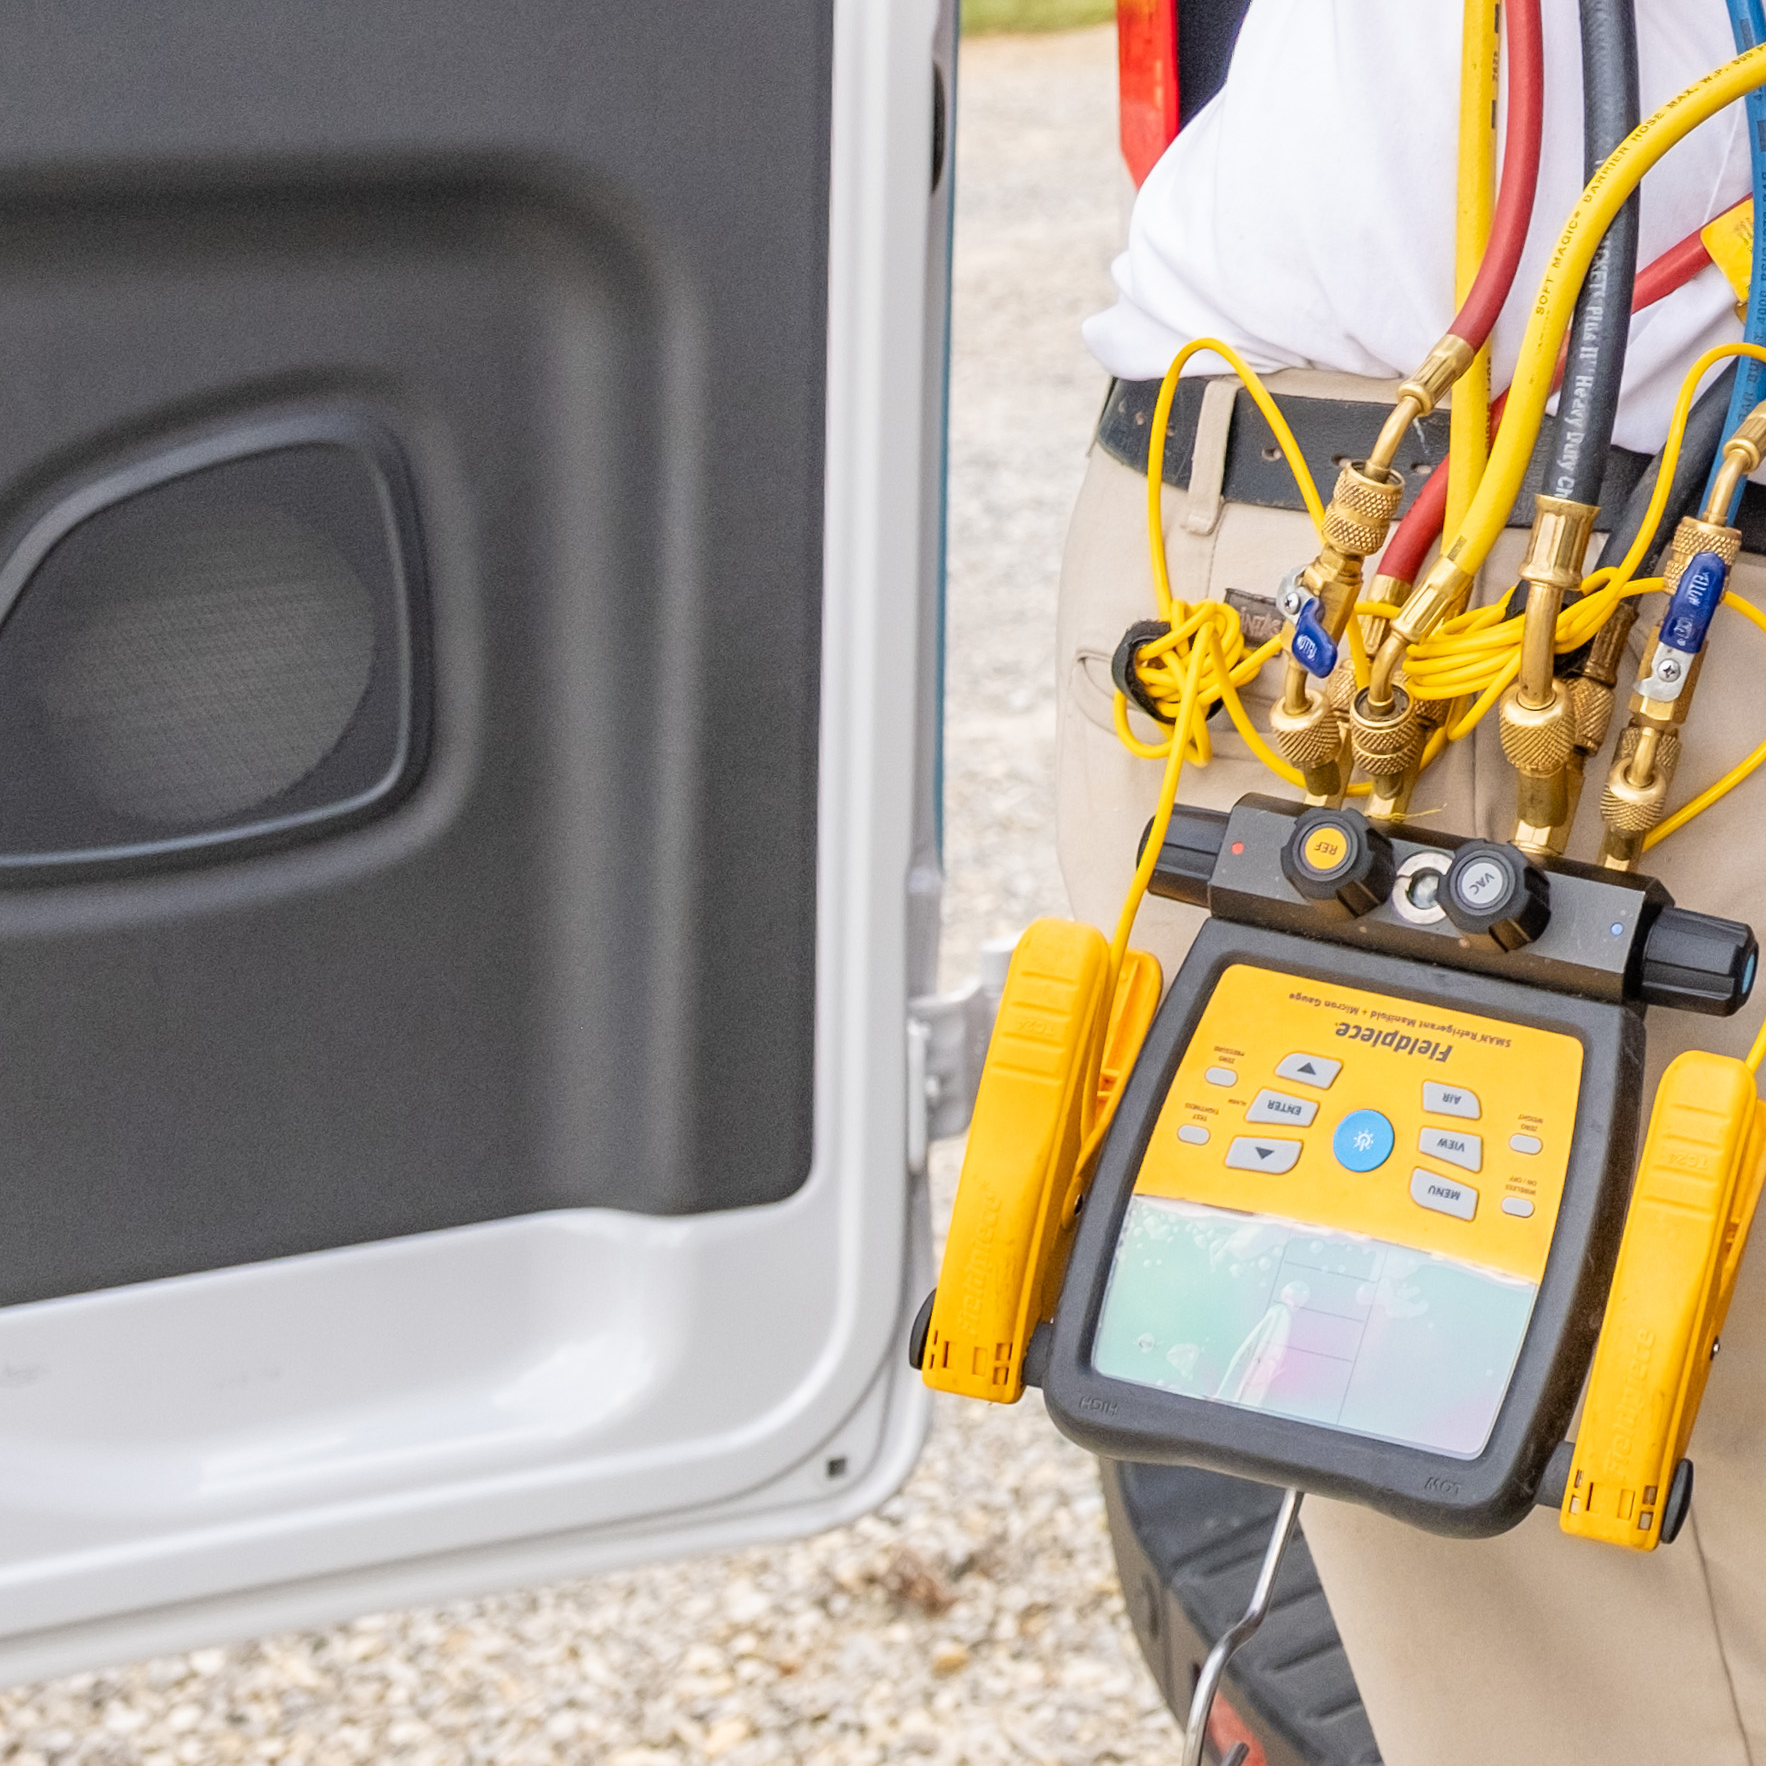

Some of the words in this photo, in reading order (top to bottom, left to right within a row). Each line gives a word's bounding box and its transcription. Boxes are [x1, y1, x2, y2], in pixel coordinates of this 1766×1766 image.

[1534, 274, 1555, 315] SOFT
[1582, 144, 1629, 204] BARRIER
[1630, 109, 1665, 143] HOSE
[1581, 304, 1603, 342] Plus
[1563, 372, 1594, 427] Heavy
[1555, 428, 1583, 471] Duty
[1554, 474, 1575, 500] Ch
[1314, 841, 1338, 856] REF
[1469, 872, 1495, 896] VAC
[1288, 992, 1319, 1010] Gauge
[1320, 1000, 1360, 1015] Micron
[1370, 1009, 1416, 1028] Manifold
[1418, 1019, 1477, 1042] Refrigerant
[1336, 1022, 1453, 1063] Fieldpiece
[1267, 1098, 1302, 1116] ENTER
[1442, 1092, 1462, 1105] AIR
[1436, 1137, 1466, 1153] VIEW
[1427, 1184, 1461, 1201] MENU
